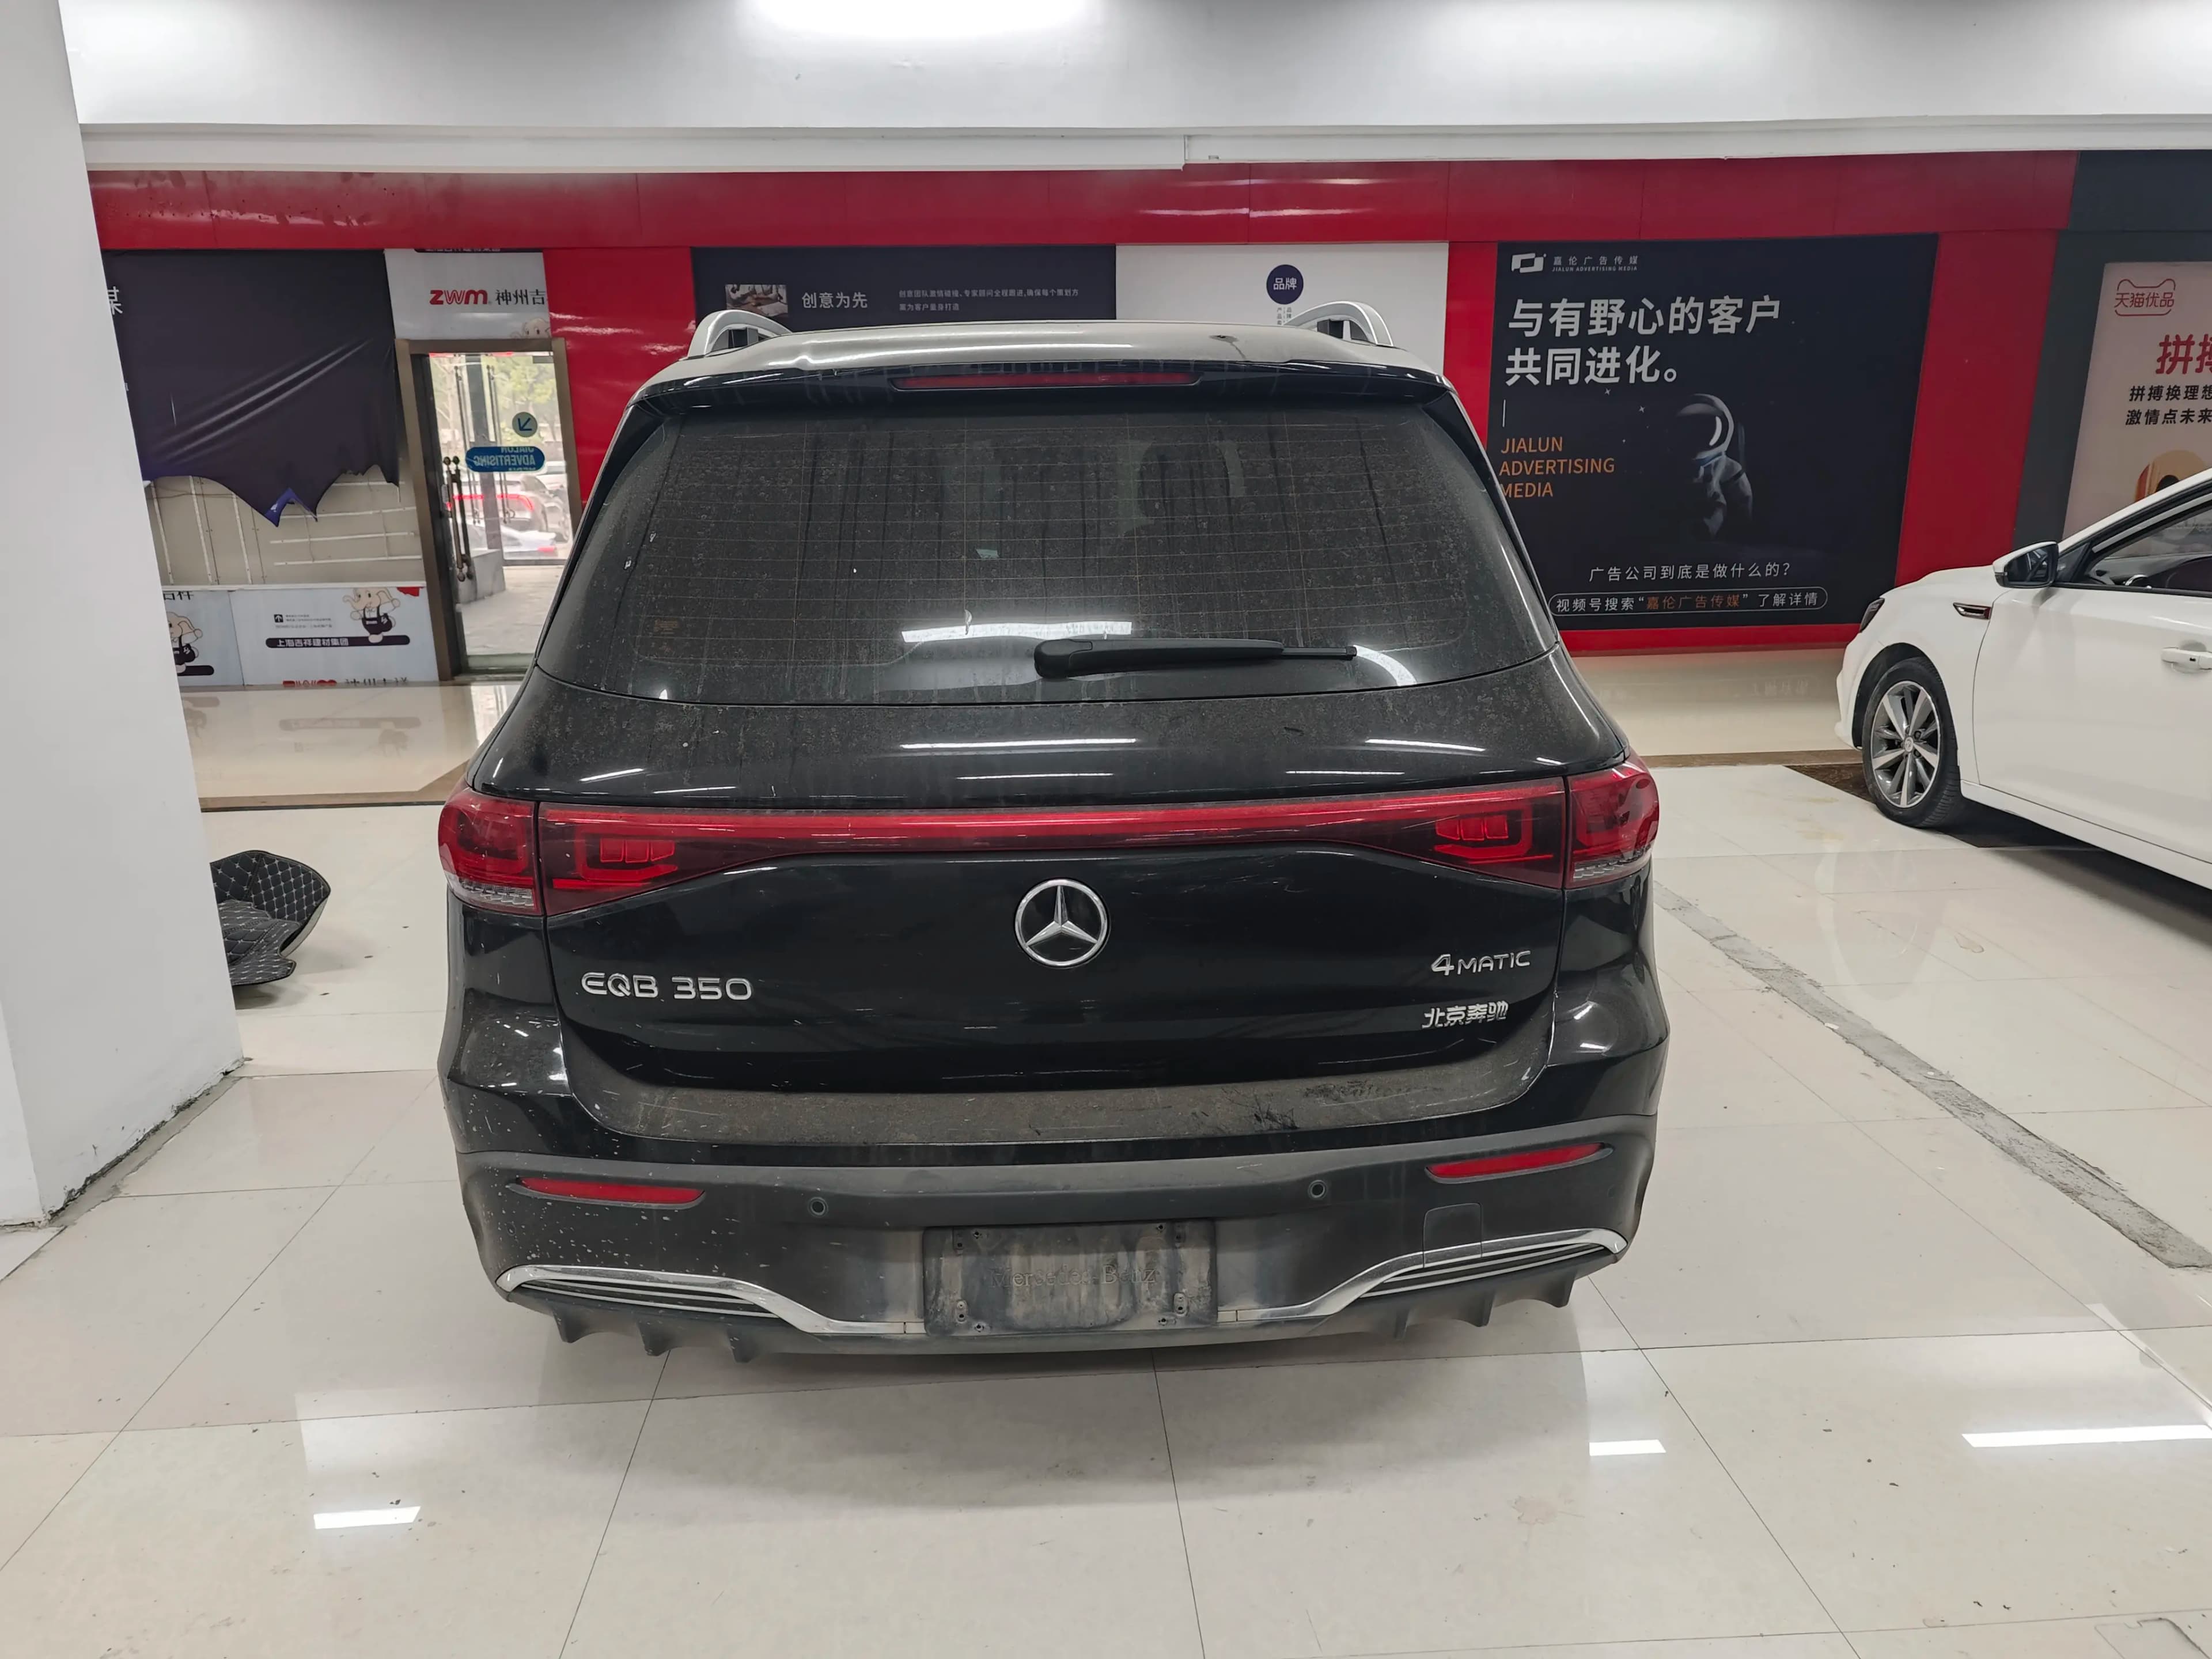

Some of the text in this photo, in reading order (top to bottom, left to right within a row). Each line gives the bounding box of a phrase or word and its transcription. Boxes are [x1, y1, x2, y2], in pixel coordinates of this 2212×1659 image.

[1273, 277, 1297, 290] 品牌
[801, 292, 868, 309] 创意为先
[2114, 291, 2175, 308] 天猫优品
[1508, 294, 1780, 337] 与有野心的客户
[1505, 346, 1677, 387] 共同进化。
[2126, 408, 2212, 426] 激情点未来
[1501, 436, 1563, 454] JIALUN
[1499, 458, 1615, 476] ADVERTISING
[1500, 482, 1554, 498] MEDIA
[1431, 950, 1531, 976] 4MATIC
[581, 972, 752, 1000] EQB 350
[1422, 1001, 1509, 1028] 北京奔驰
